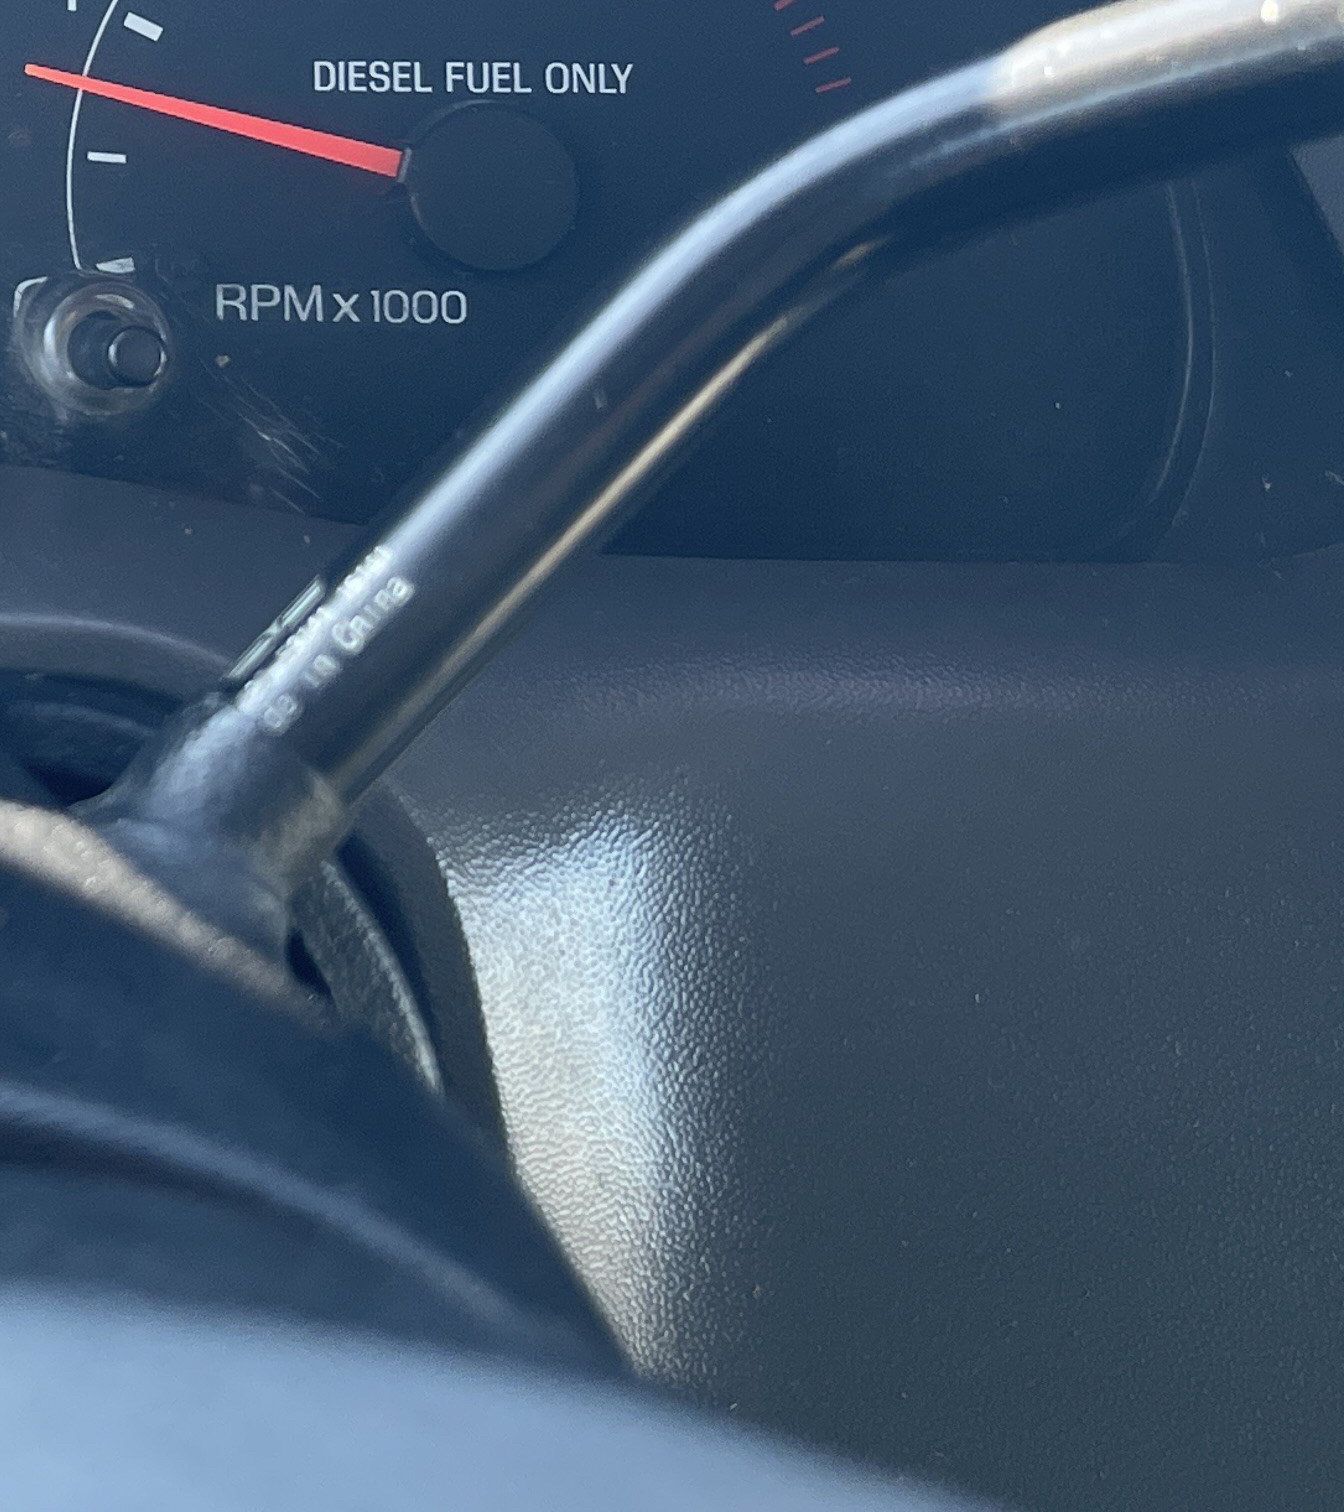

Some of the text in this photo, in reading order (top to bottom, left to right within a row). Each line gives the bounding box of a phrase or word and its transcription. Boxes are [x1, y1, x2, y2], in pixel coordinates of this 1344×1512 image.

[313, 60, 633, 94] DIESEL FUEL ONLY
